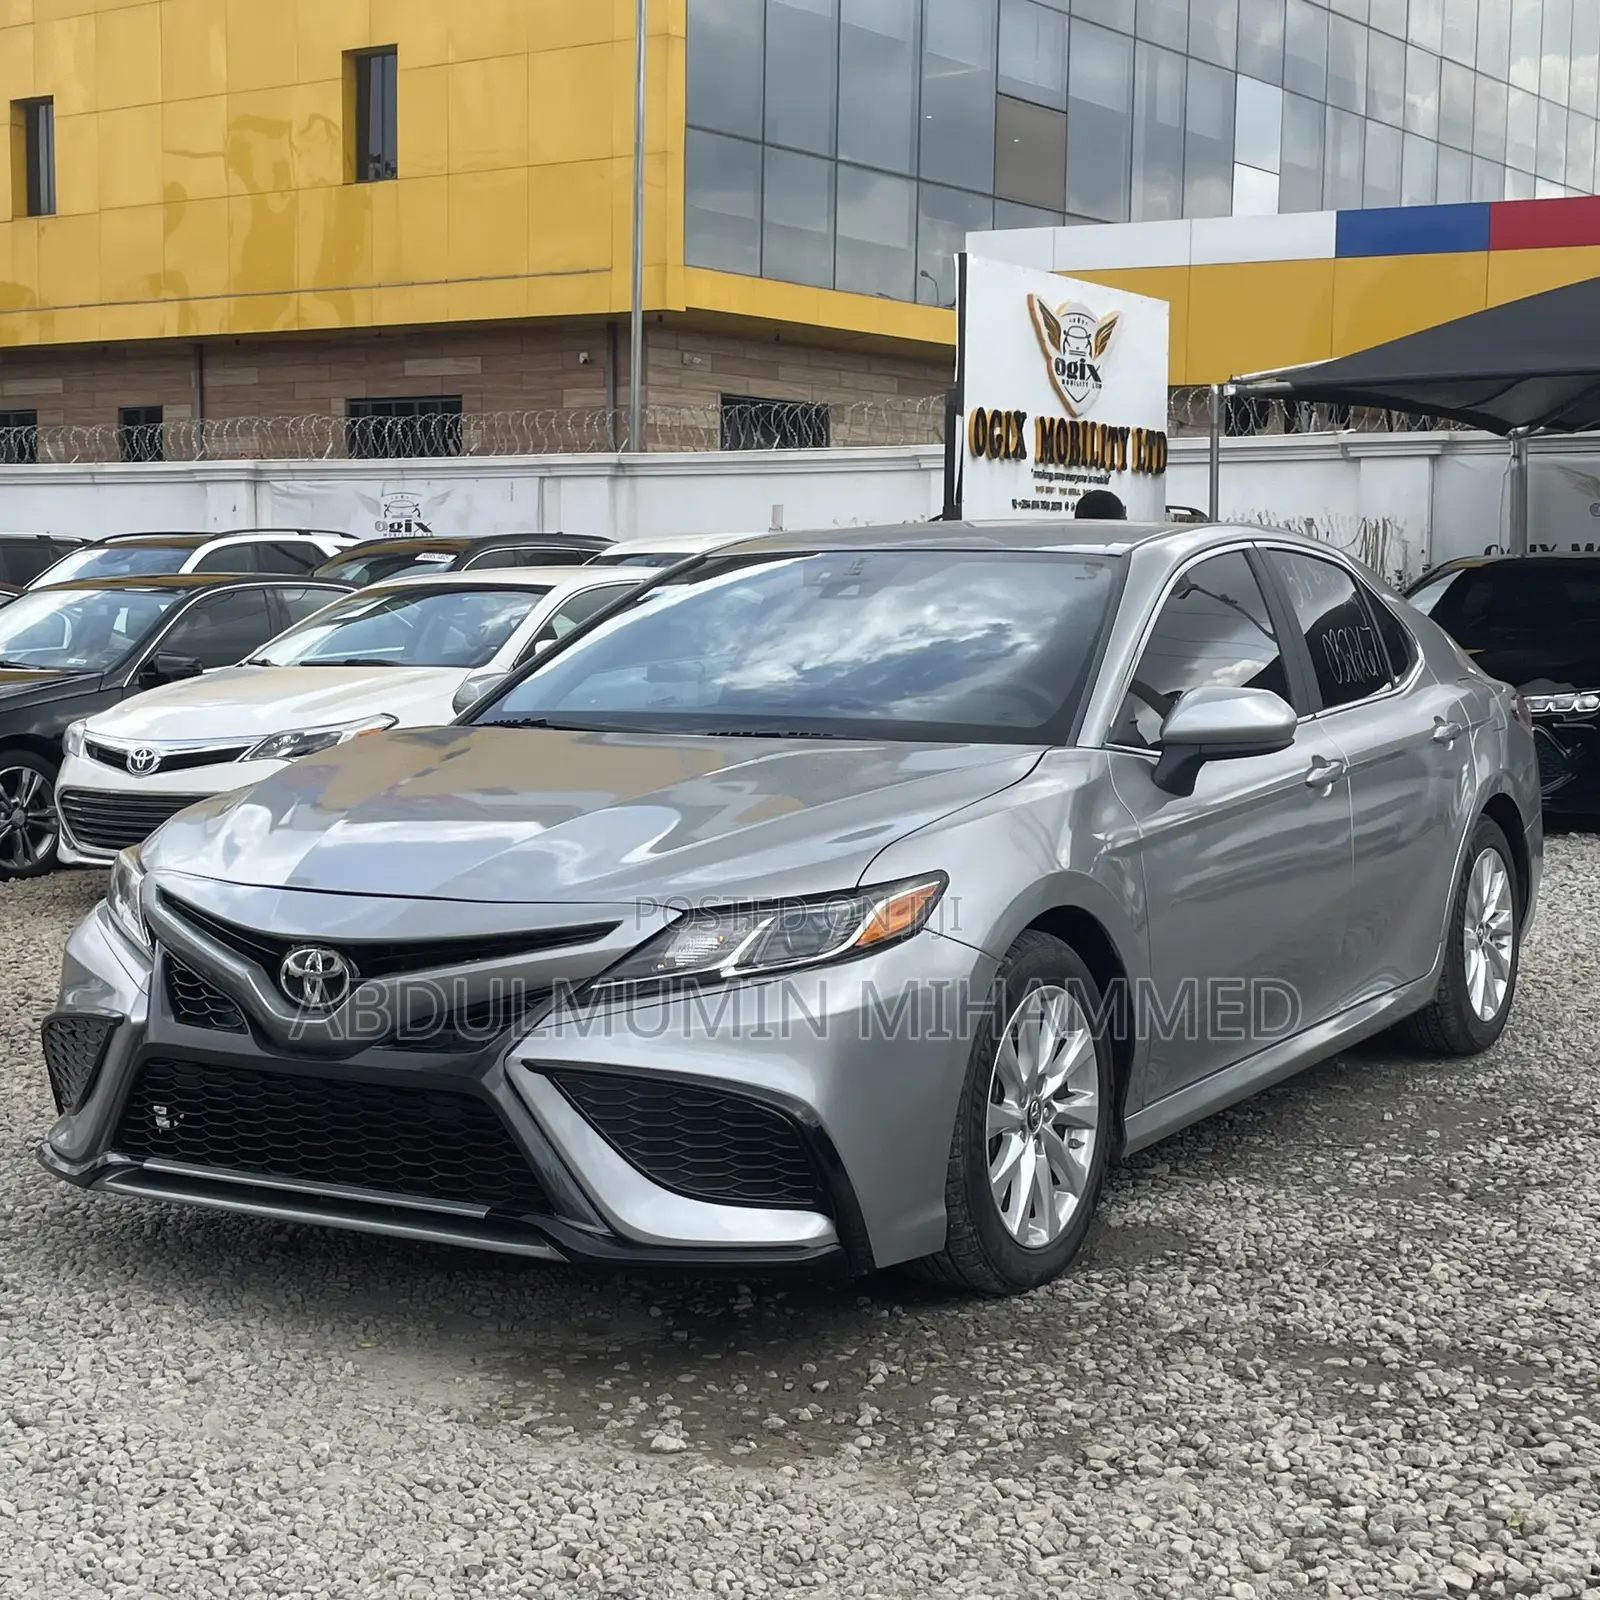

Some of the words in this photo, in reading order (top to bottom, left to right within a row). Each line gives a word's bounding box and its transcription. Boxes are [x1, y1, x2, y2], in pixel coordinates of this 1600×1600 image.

[968, 407, 1028, 460] OGIX
[1034, 415, 1130, 471] MOBILITY
[1131, 427, 1168, 475] LTD
